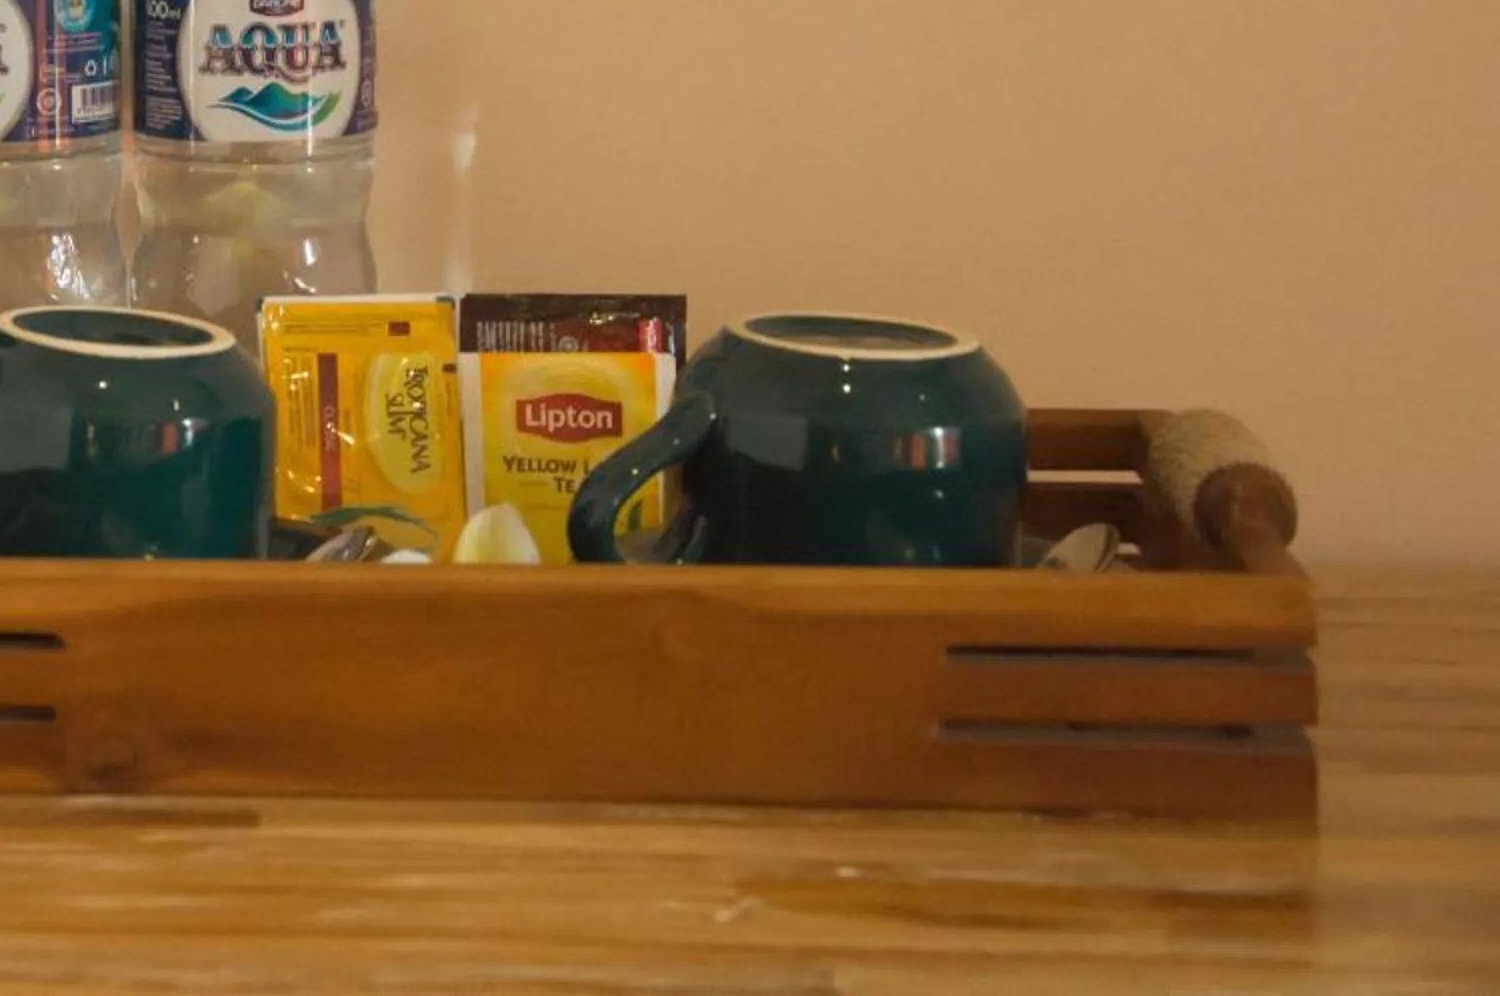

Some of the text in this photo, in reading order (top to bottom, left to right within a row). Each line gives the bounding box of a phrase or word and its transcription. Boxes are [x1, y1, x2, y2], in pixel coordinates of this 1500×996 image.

[198, 19, 347, 84] AQUA
[524, 402, 614, 434] Lipton
[502, 455, 577, 474] YELLOW
[553, 475, 576, 494] TE
